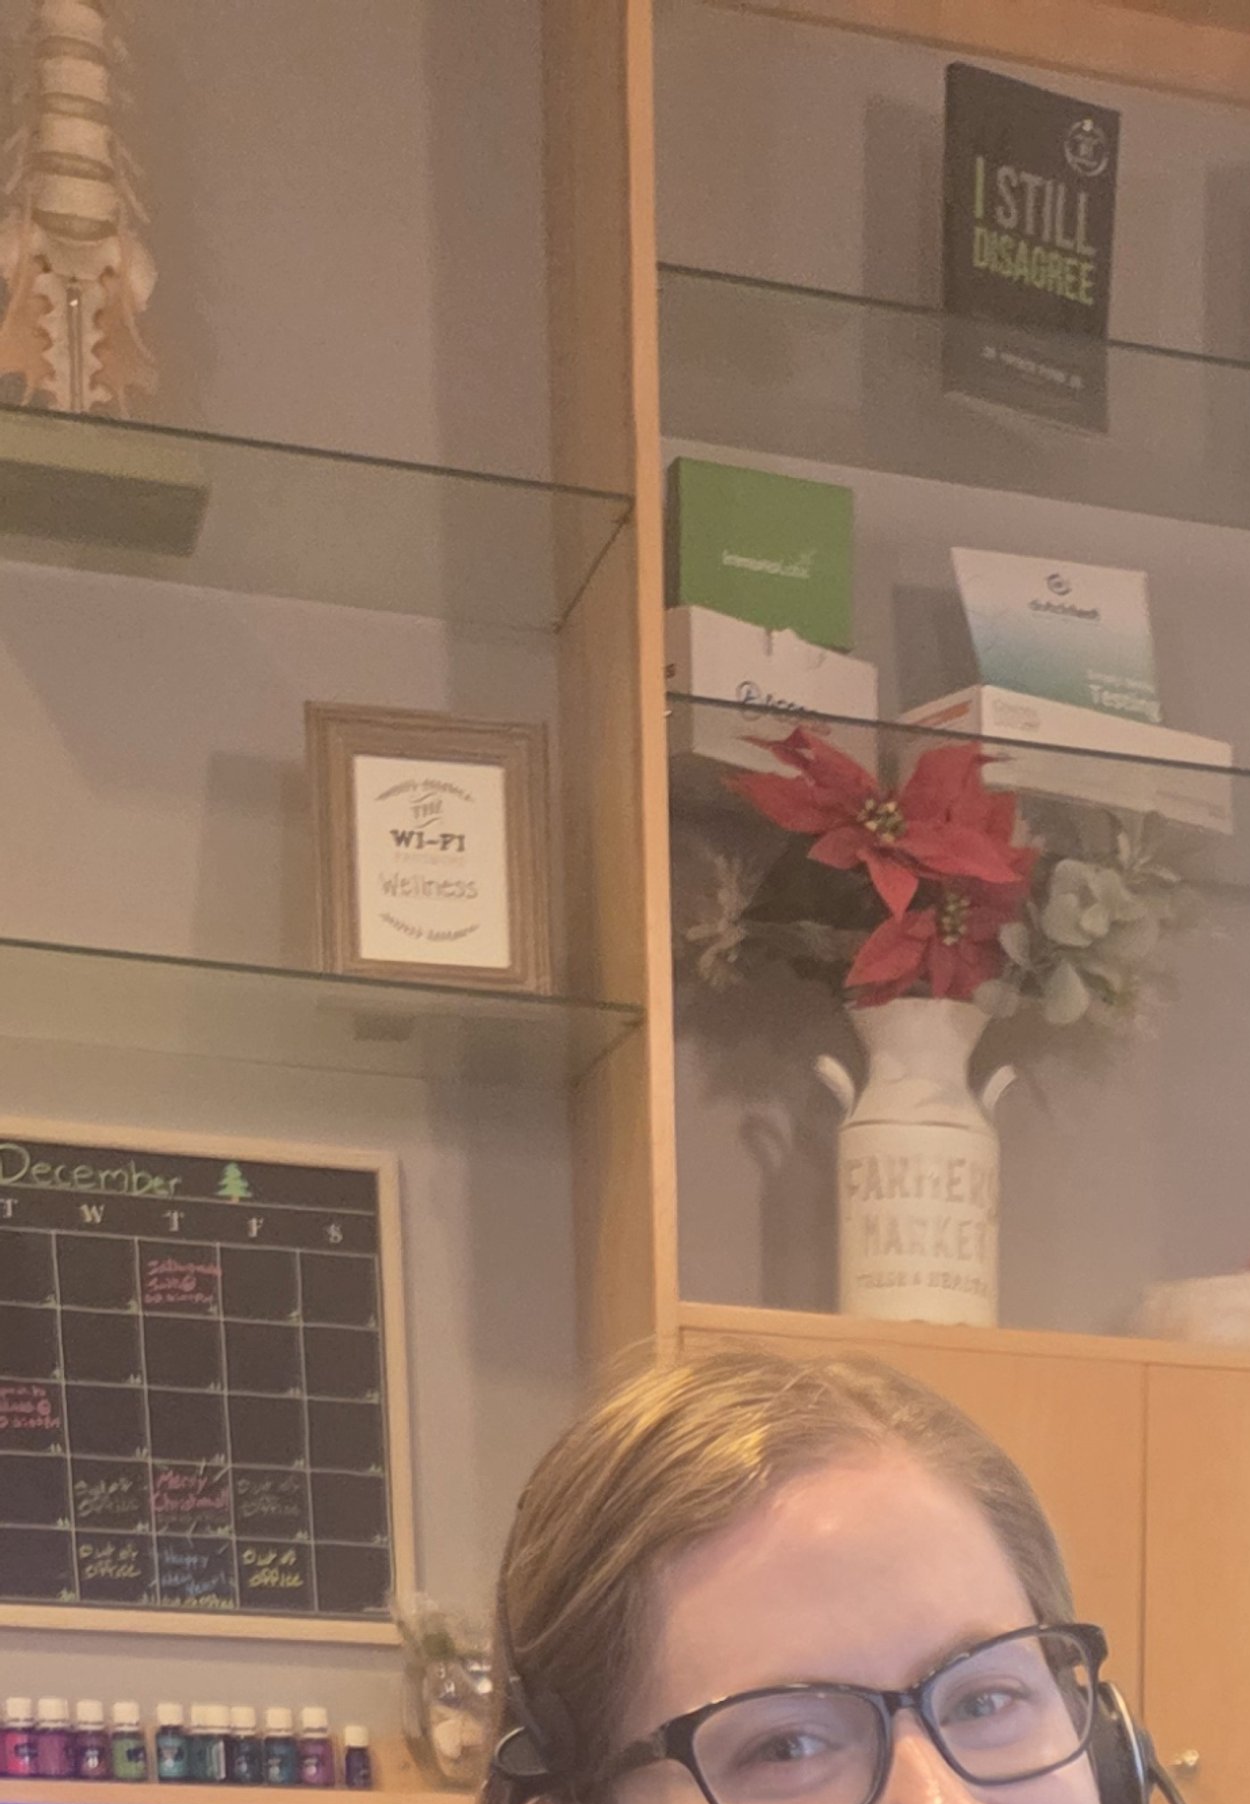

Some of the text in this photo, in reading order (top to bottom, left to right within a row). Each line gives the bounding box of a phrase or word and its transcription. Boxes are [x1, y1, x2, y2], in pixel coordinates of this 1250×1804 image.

[975, 156, 1097, 255] I STILL
[973, 226, 1095, 305] DISAGREE
[0, 1143, 182, 1197] December
[80, 1203, 105, 1224] W
[162, 1209, 185, 1232] T
